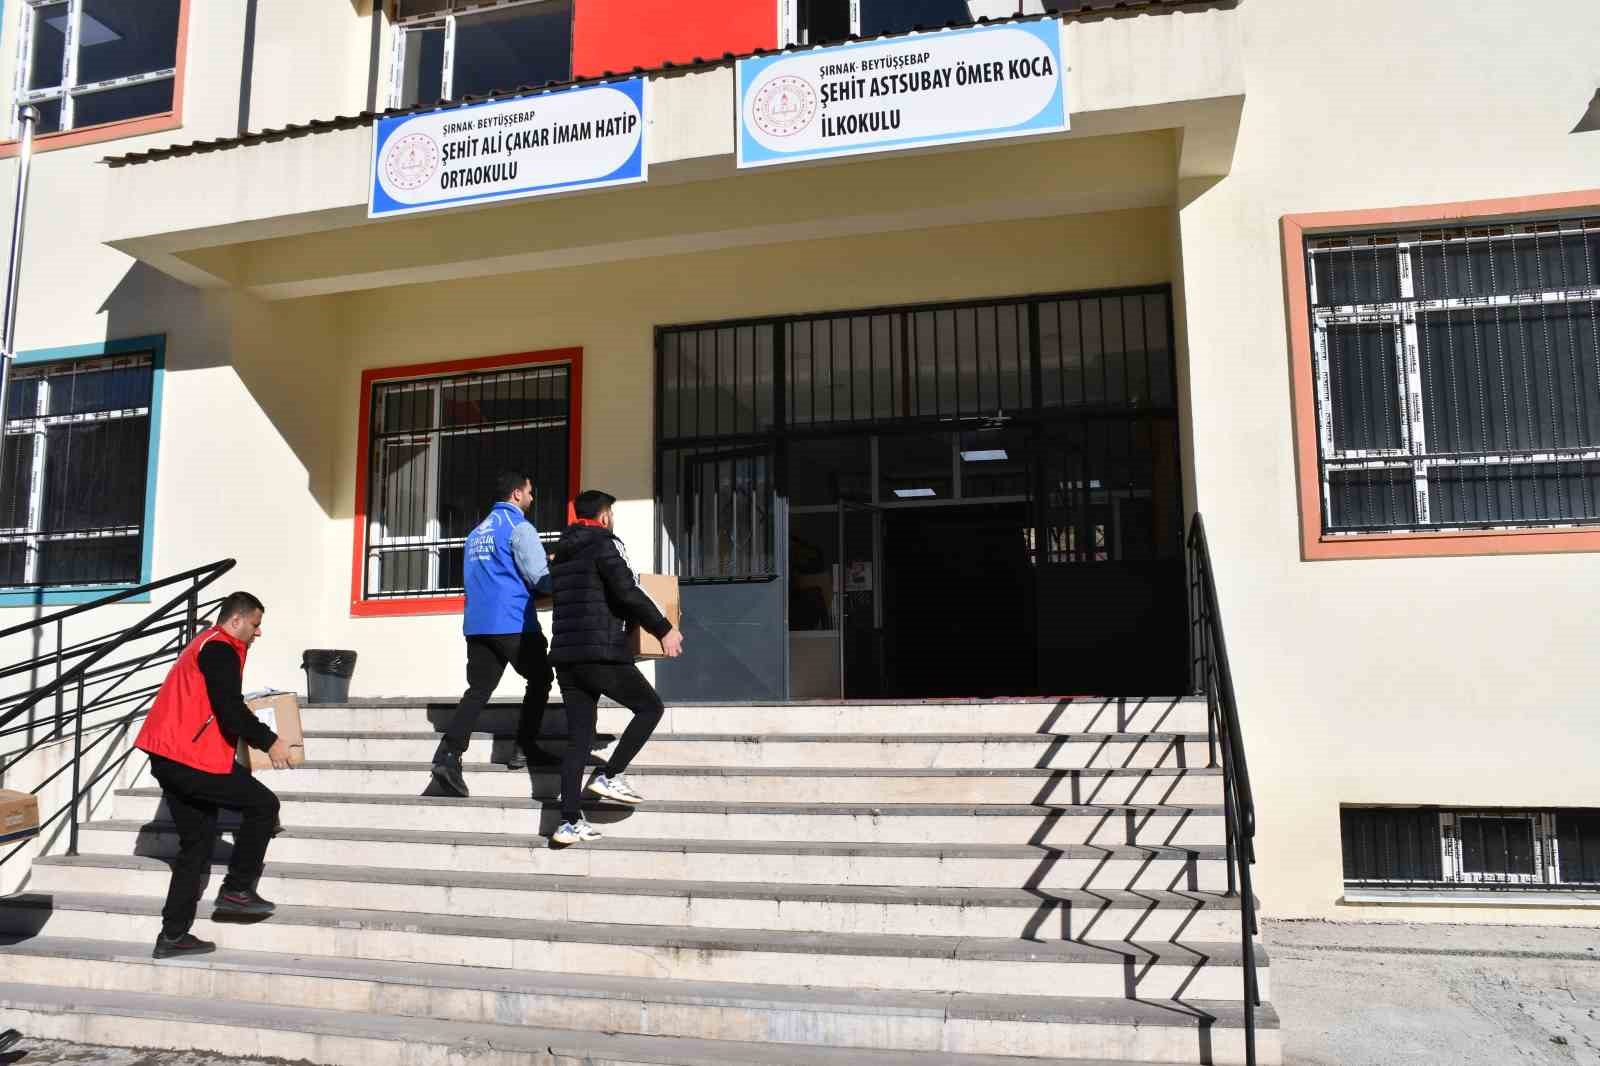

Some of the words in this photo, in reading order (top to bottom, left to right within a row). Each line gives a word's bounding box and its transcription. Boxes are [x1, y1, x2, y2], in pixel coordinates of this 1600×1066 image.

[820, 62, 859, 80] ŞIRNAK-
[861, 52, 930, 71] BEYTÜŞŞEBAP
[820, 75, 866, 109] ŞEHİT
[870, 67, 952, 97] ASTSUBAY
[956, 61, 1004, 86] ÖMER
[1008, 55, 1053, 80] KOCA
[477, 110, 536, 129] BEYTÜŞŞEBAP
[821, 109, 901, 138] İLKOKULU
[441, 135, 479, 167] ŞEHİT
[481, 130, 502, 155] ALİ
[505, 128, 550, 157] ÇAKAR
[553, 122, 591, 145] İMAM
[595, 111, 637, 139] HATİP
[440, 161, 518, 190] ORTAOKULU
